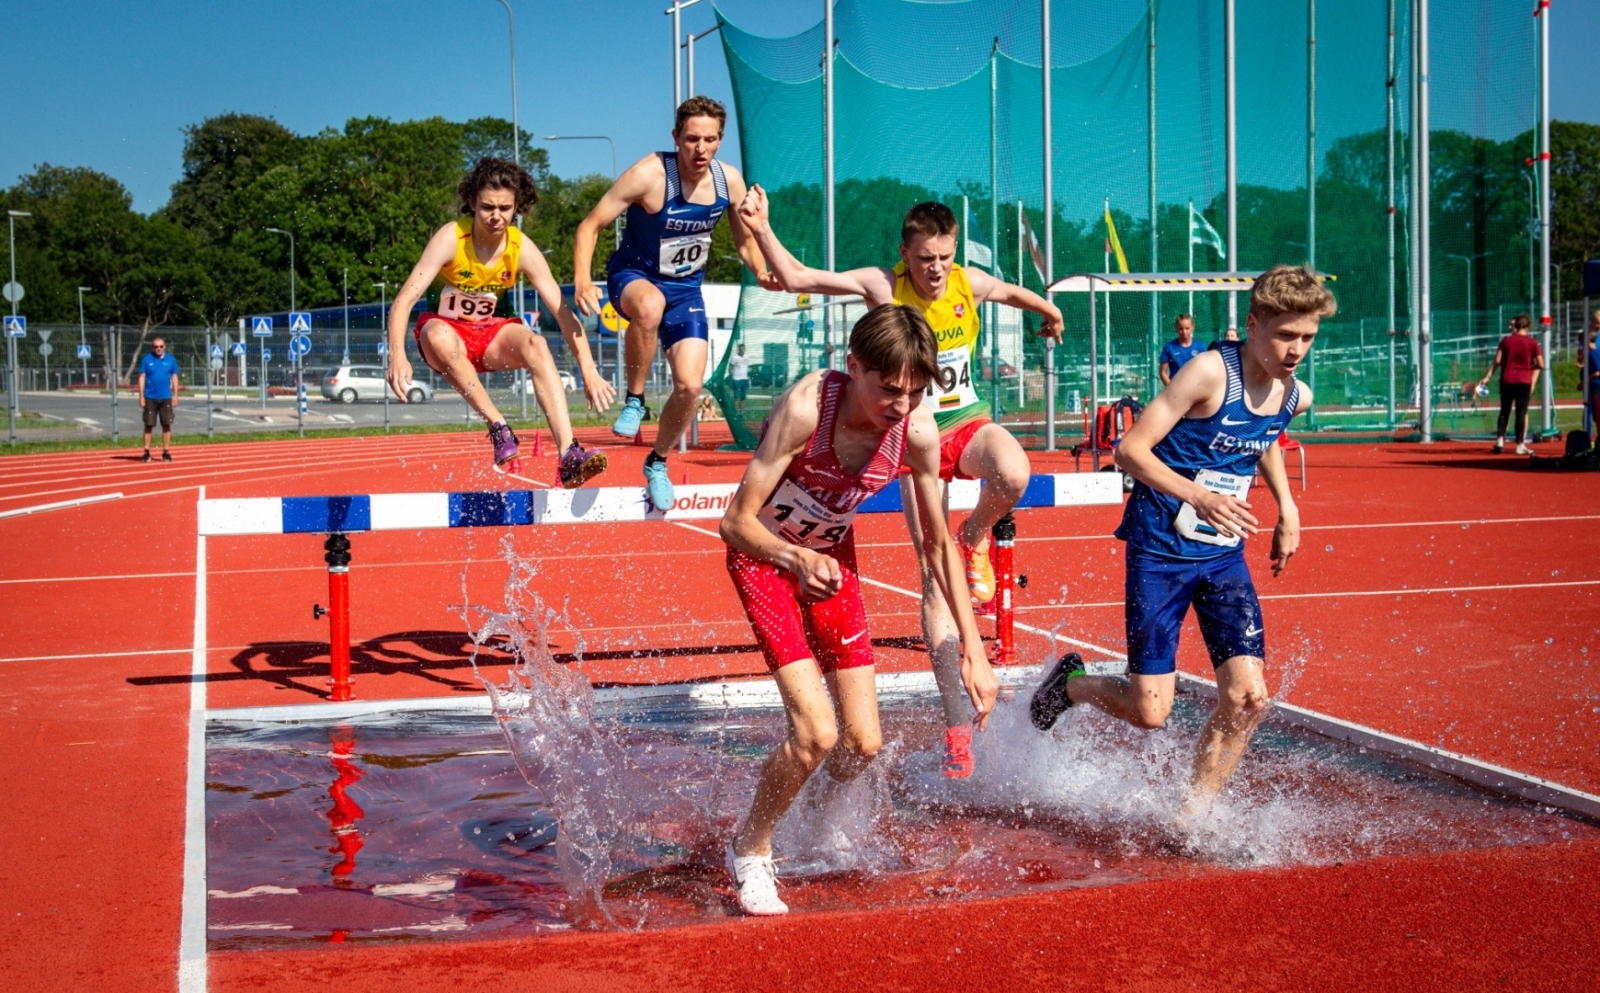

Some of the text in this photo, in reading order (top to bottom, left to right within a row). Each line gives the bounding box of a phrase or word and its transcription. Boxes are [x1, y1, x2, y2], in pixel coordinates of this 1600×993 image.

[671, 244, 702, 265] 40
[448, 295, 494, 316] 193
[935, 326, 964, 342] UVA
[926, 361, 970, 397] 194
[1209, 431, 1269, 456] ESTONI
[774, 503, 847, 543] 118
